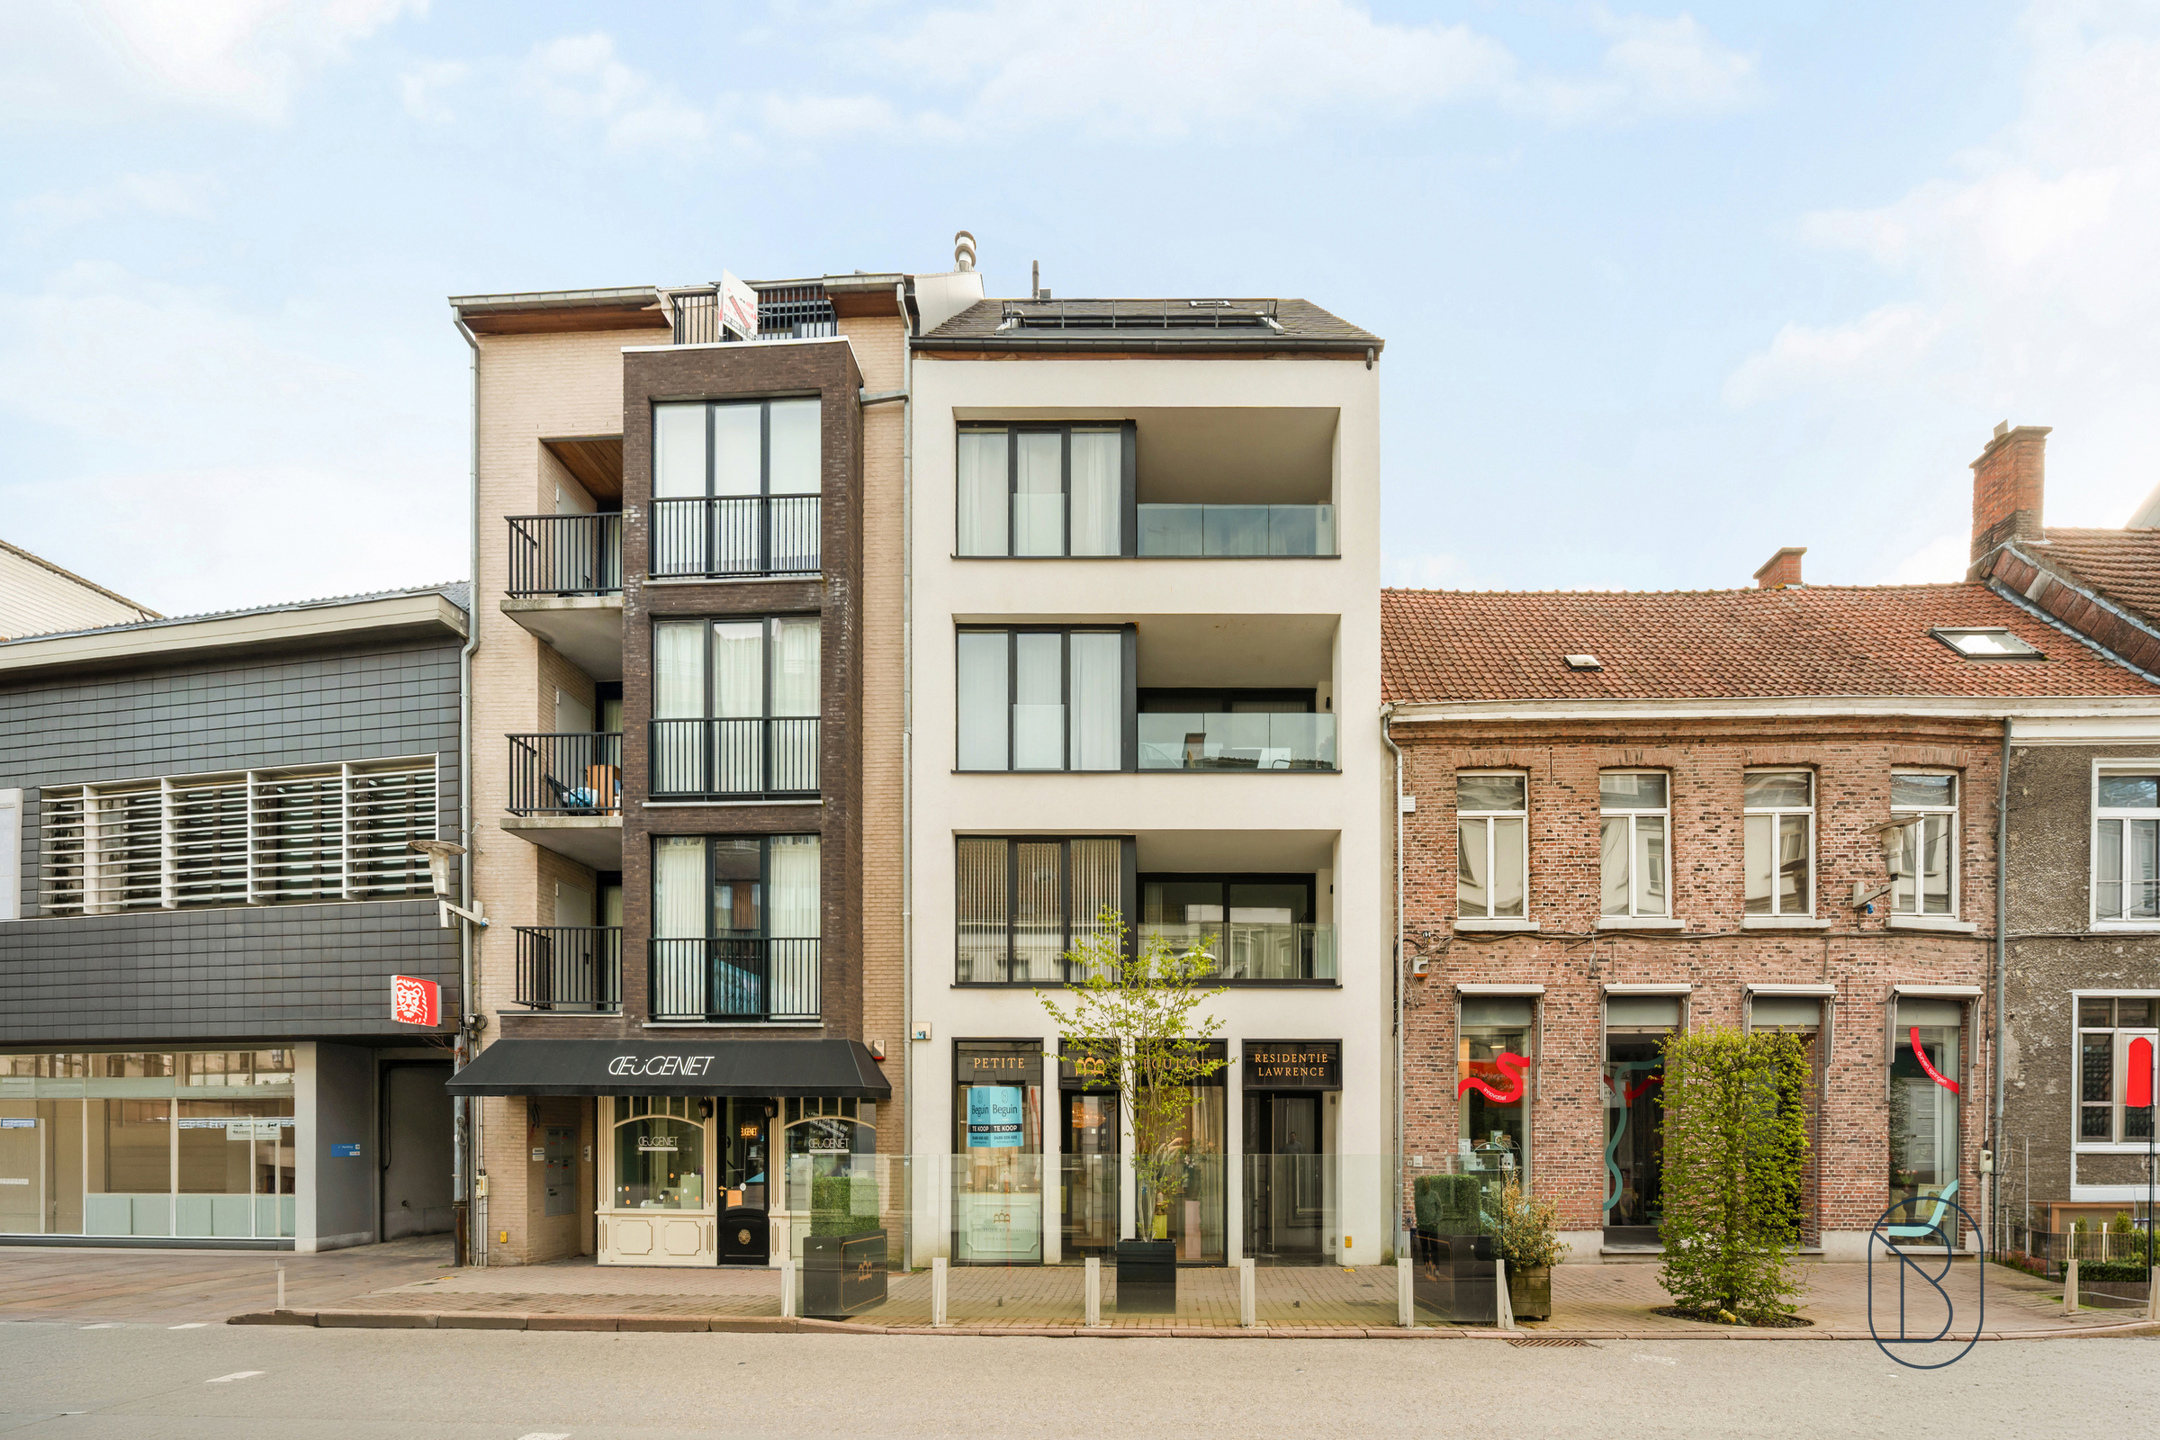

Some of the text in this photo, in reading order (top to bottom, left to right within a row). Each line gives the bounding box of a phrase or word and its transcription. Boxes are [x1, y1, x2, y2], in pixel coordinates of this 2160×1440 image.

[973, 1057, 1025, 1069] PETITE
[1254, 1053, 1328, 1063] RESIDENTIE
[1917, 1051, 1930, 1069] durven
[1258, 1067, 1325, 1077] LAWRENCE
[971, 1104, 989, 1118] Beguin
[992, 1103, 1018, 1118] Beguin
